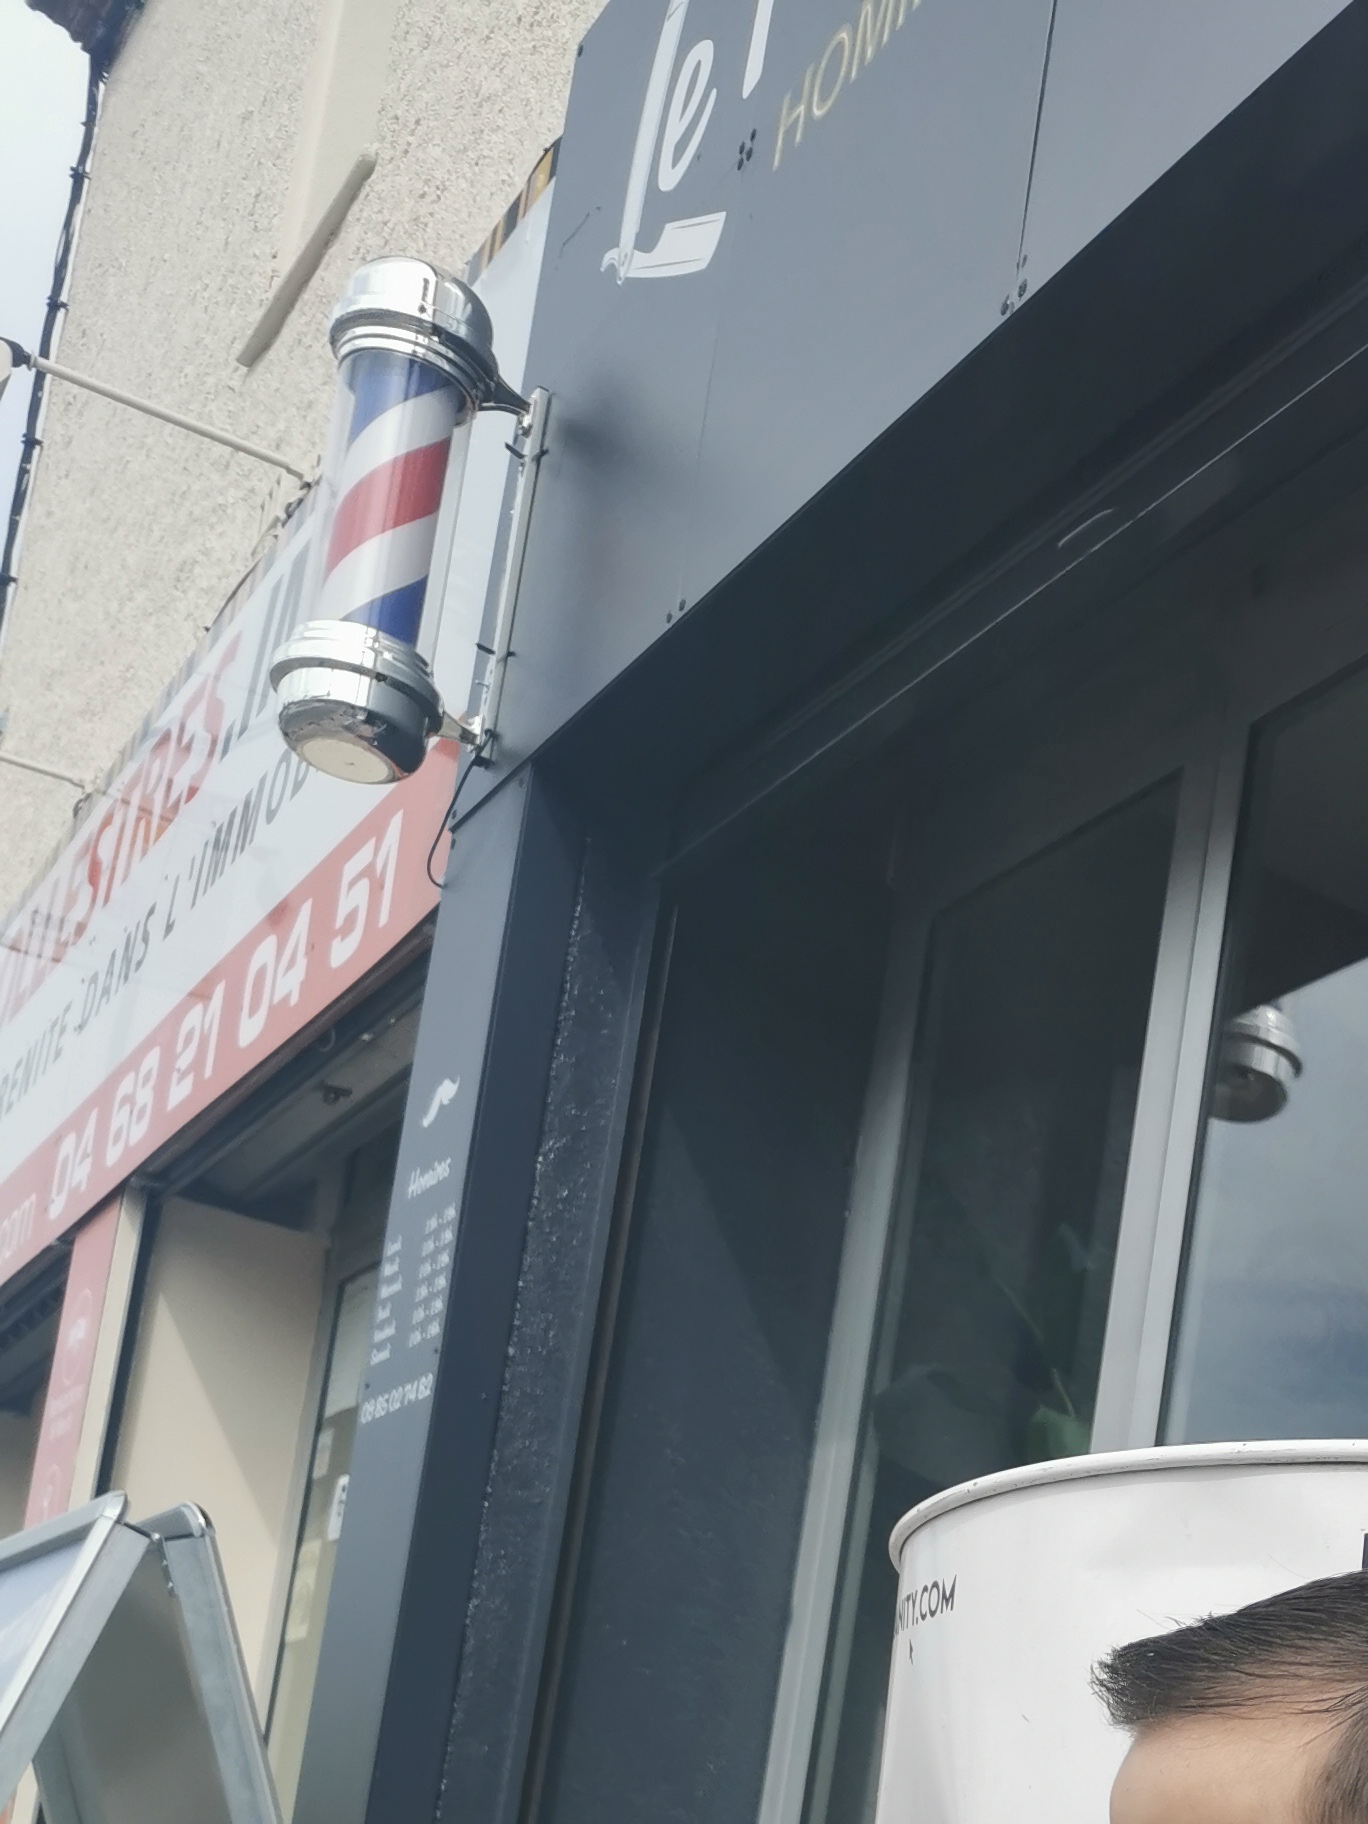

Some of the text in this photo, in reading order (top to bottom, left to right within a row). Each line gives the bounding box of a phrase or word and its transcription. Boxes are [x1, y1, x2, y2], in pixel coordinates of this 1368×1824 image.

[772, 0, 922, 171] HOM
[48, 1107, 98, 1220] 04
[106, 1045, 160, 1167] 68
[166, 979, 226, 1112] 21
[238, 897, 313, 1048] 04
[330, 808, 403, 969] 51
[76, 901, 157, 1035] DANS
[894, 1574, 957, 1636] NITY.COM
